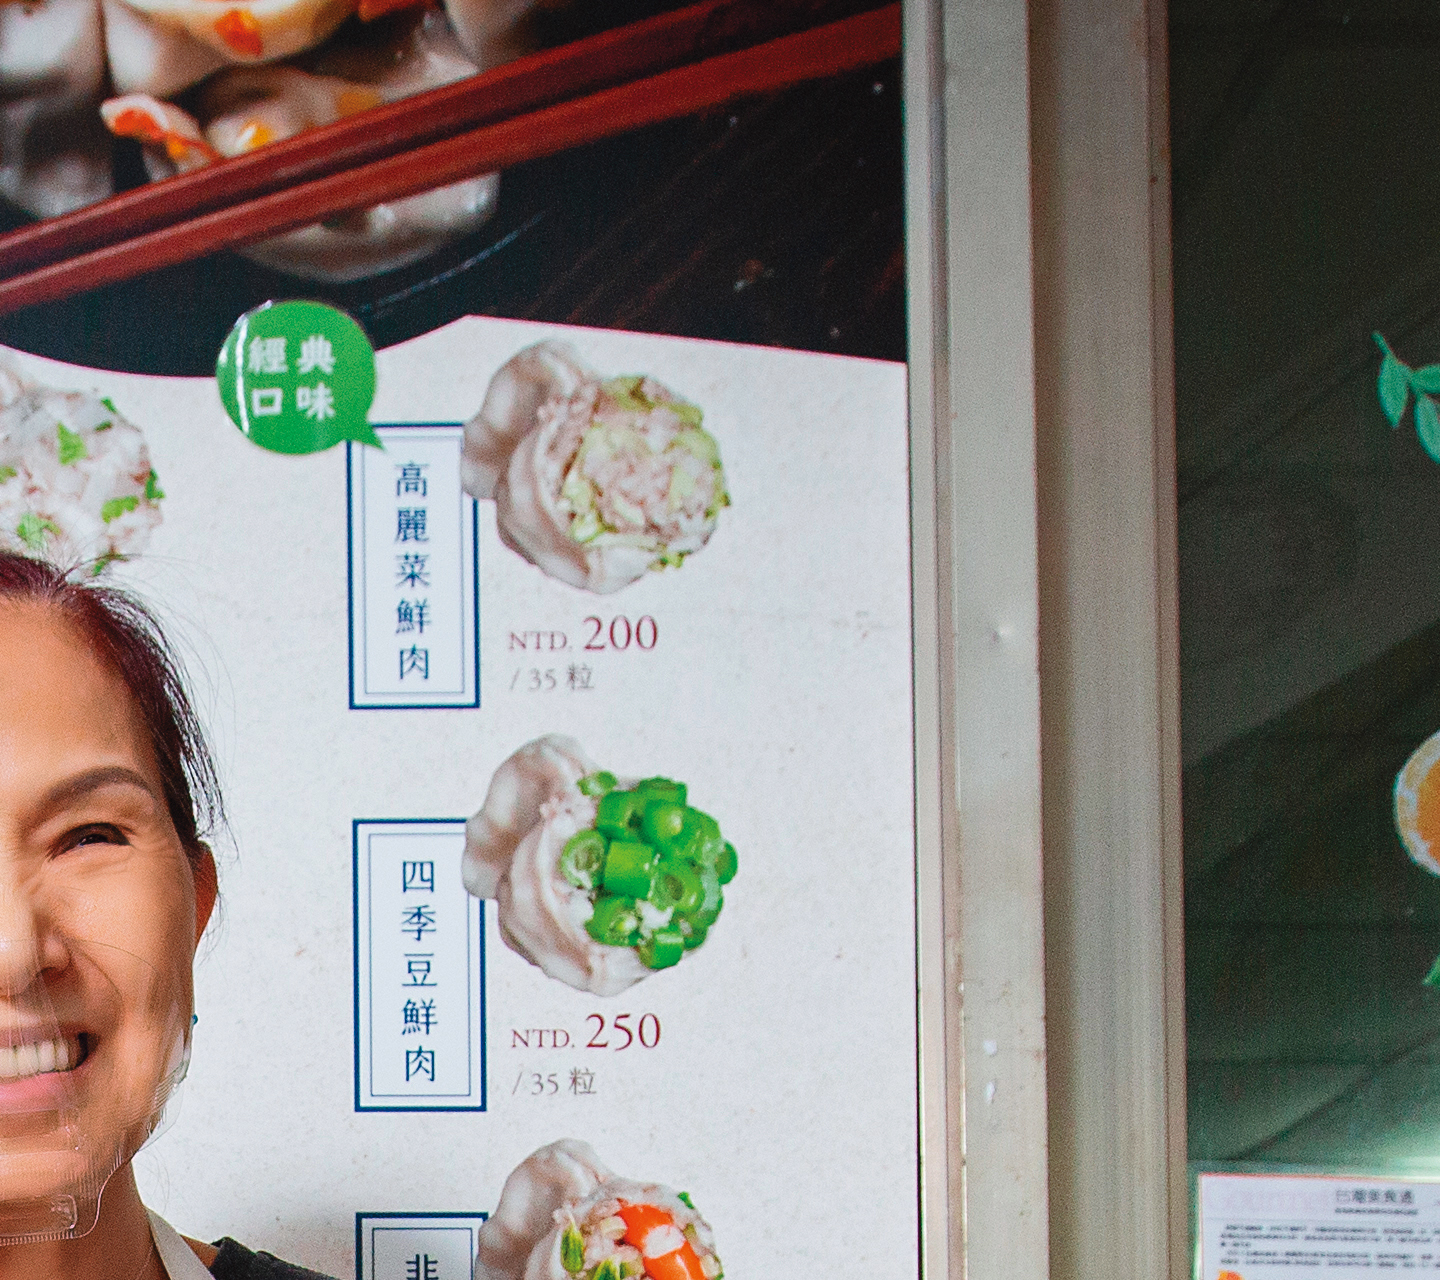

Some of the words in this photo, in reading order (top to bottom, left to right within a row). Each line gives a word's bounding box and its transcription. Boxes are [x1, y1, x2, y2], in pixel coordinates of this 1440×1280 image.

[247, 336, 336, 373] 經典
[250, 385, 336, 420] 口味
[396, 463, 429, 680] 高麗菜鮮肉
[509, 631, 568, 651] NTD.
[584, 616, 658, 650] 200
[402, 861, 437, 1082] 四季豆鮮肉
[512, 1029, 575, 1048] NTD.
[586, 1014, 661, 1050] 250
